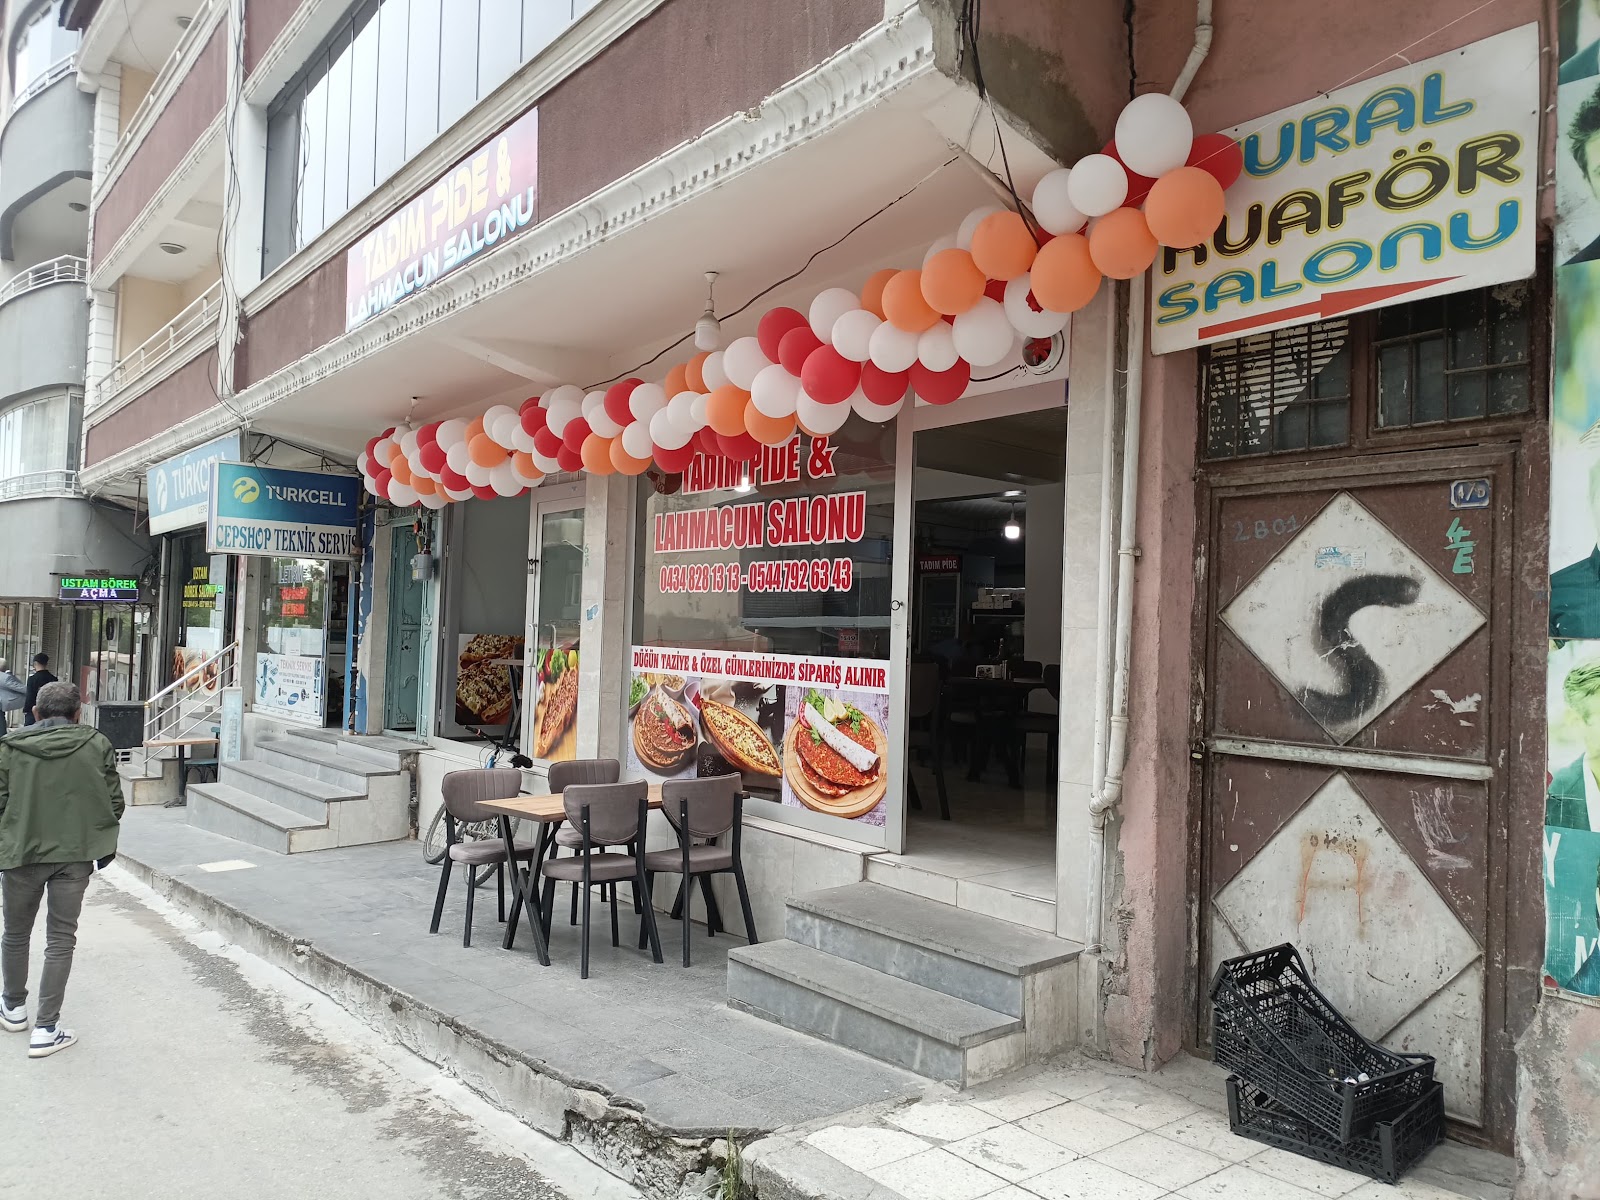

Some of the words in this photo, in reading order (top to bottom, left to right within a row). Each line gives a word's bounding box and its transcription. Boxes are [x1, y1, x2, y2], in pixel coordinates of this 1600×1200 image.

[1238, 71, 1475, 177] URAL
[362, 198, 426, 286] TADIM
[496, 136, 511, 198] &
[348, 247, 439, 323] LAHMACUN
[442, 186, 534, 272] SALONU
[1156, 199, 1521, 326] SALONU
[807, 436, 839, 479] &
[266, 484, 347, 507] TURKCELL
[216, 524, 272, 550] CEPSHOP
[274, 526, 316, 553] TEKNİK
[654, 502, 765, 553] LAHMACUN
[767, 491, 866, 547] SALONU
[61, 578, 99, 588] USTAM
[100, 577, 137, 589] BÖREK
[659, 564, 687, 593] 0434
[687, 563, 710, 593] 828
[711, 563, 725, 593] 13
[726, 562, 741, 592] 13
[748, 561, 783, 592] 0544
[782, 559, 809, 592] 792
[809, 558, 830, 592] 63
[831, 557, 852, 592] 43
[920, 560, 940, 570] TADIM
[942, 557, 957, 570] PİDE
[80, 588, 118, 600] AÇMA
[633, 648, 659, 669] DÜĞÜN
[661, 651, 690, 672] TAZİYE
[691, 660, 698, 671] &
[700, 652, 723, 675] ÖZEL
[725, 654, 796, 680] GÜNLERİNİZDE
[798, 659, 842, 689] SİPARİŞ
[844, 666, 886, 688] ALINIR
